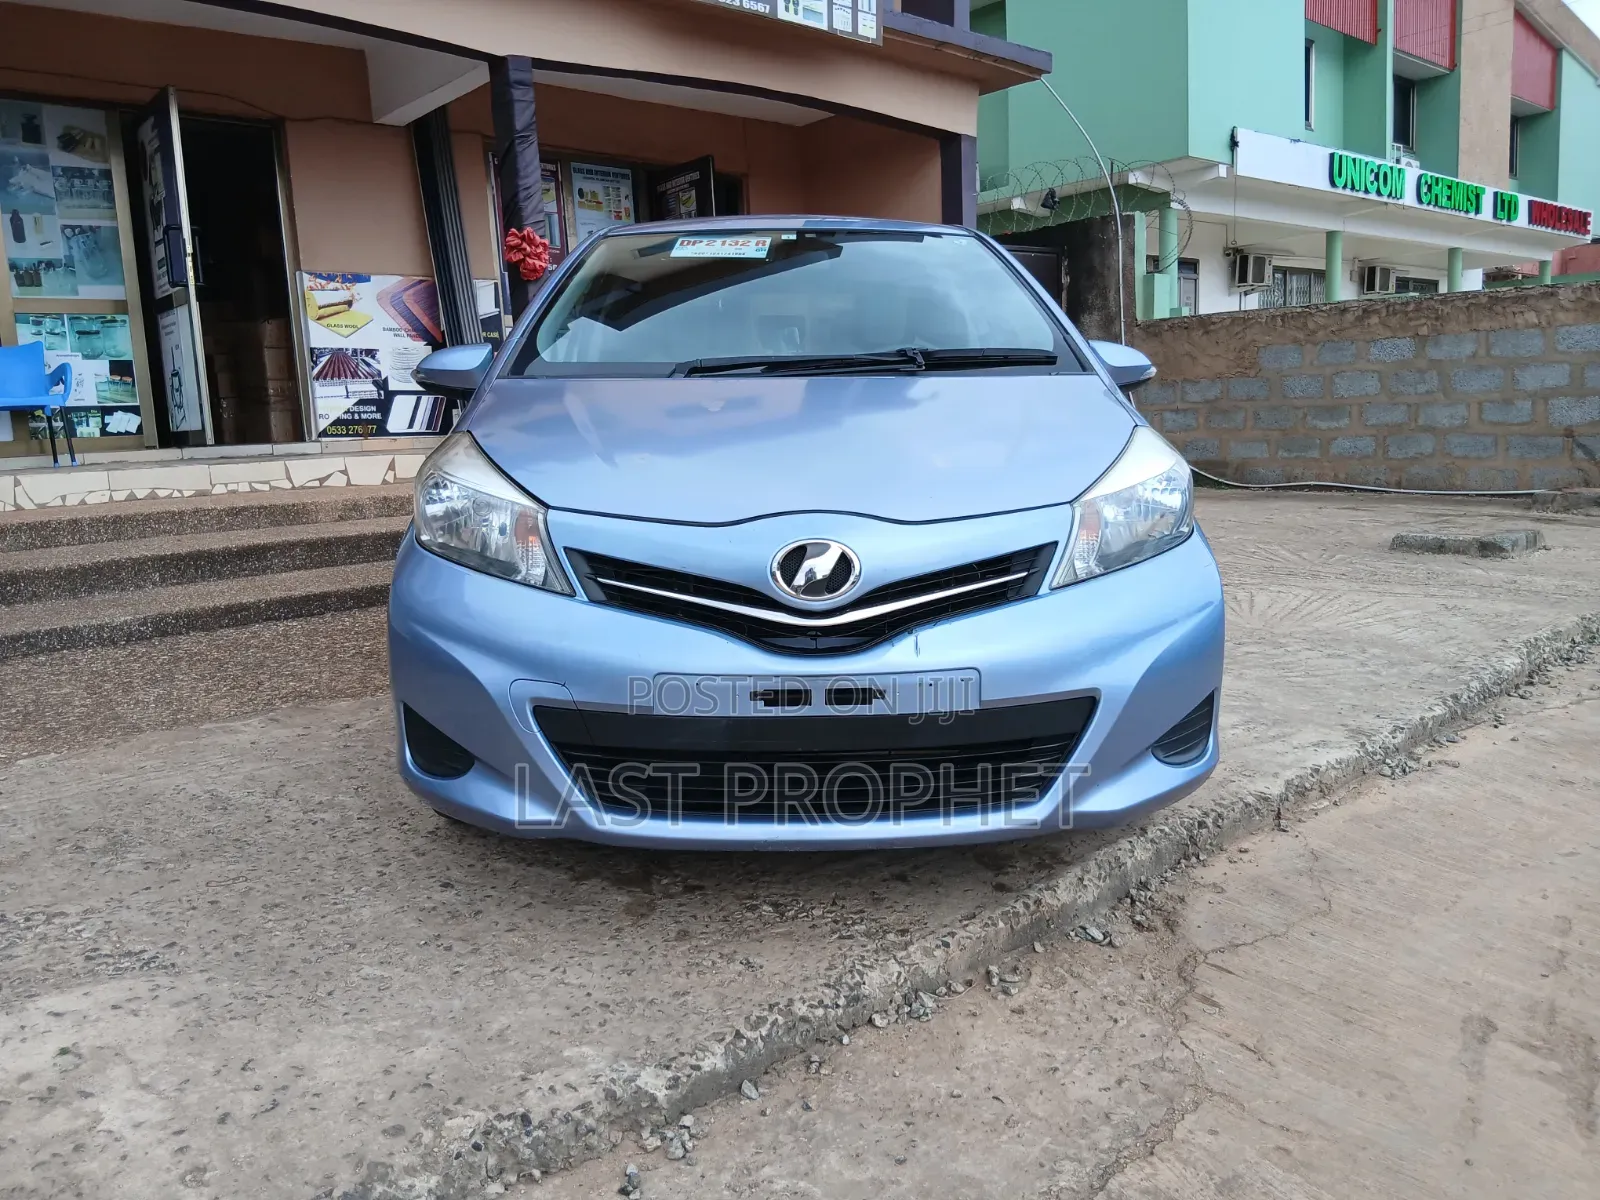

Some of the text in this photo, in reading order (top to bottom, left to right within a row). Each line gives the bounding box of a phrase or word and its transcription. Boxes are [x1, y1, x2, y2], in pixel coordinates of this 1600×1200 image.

[742, 0, 770, 13] 6567
[1330, 152, 1592, 236] UNICOM CHEMIST LTD WHOLESALE
[326, 425, 347, 434] 0533
